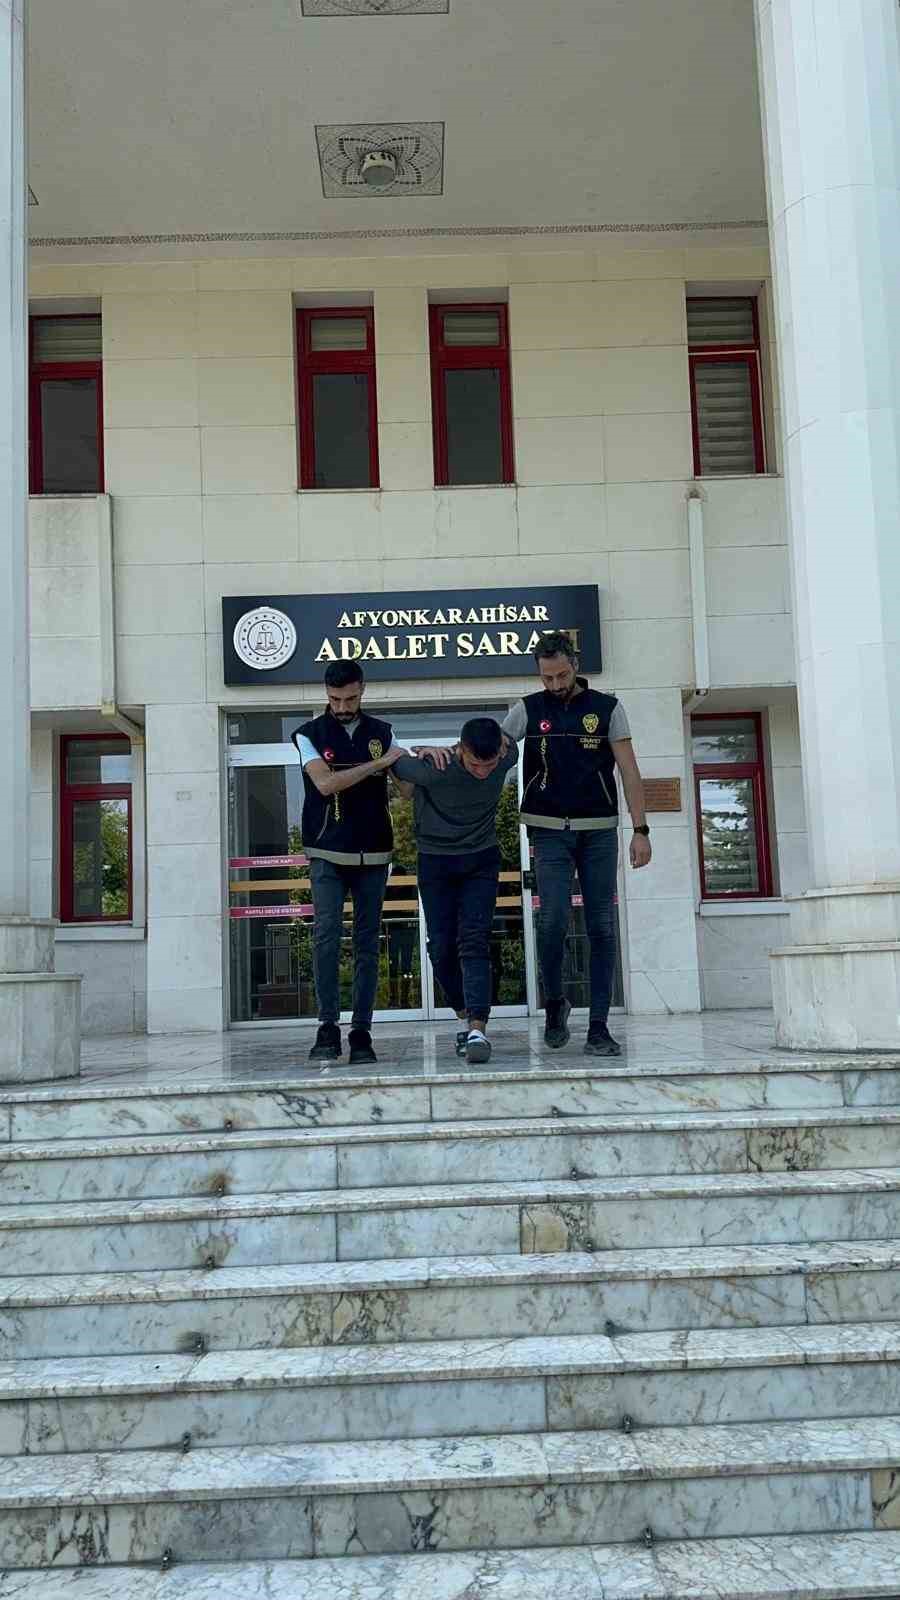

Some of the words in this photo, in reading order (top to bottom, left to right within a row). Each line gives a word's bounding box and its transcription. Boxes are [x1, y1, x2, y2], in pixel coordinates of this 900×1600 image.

[337, 604, 549, 627] AFYONKARAHİSAR
[315, 633, 449, 662] ADALET
[457, 629, 581, 658] SARAI
